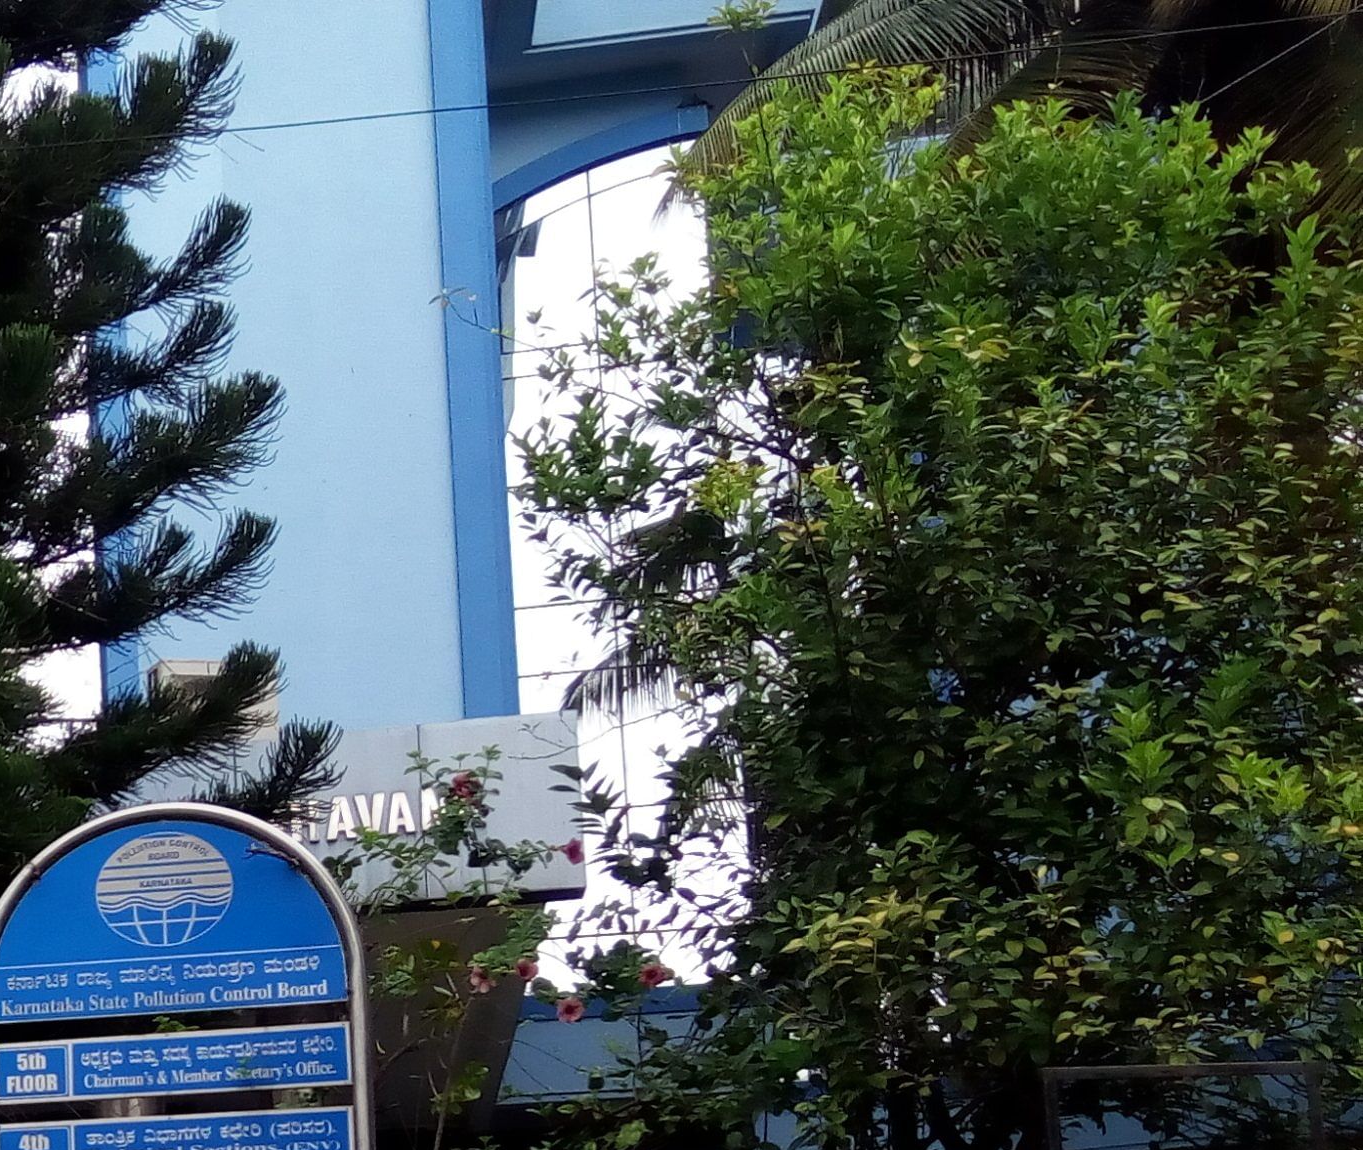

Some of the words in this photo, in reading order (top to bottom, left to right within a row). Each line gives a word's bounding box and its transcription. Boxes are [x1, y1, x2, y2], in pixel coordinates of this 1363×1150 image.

[139, 878, 193, 888] KARNATAKA
[6, 974, 68, 991] ಕರ್ನಾಟಕ
[75, 971, 113, 990] ರಾಜ್ಯ
[119, 964, 175, 986] ಮಾಲಿನ್ಯ
[183, 960, 256, 983] ನಿಯಂತ್ರಣ
[263, 954, 321, 974] ಮಂಡಳಿ
[1, 997, 84, 1017] Karnataka
[89, 994, 129, 1011] State
[133, 988, 205, 1008] Pollution
[209, 983, 273, 1003] Control
[277, 979, 328, 998] Board
[16, 1052, 47, 1072] 5th
[6, 1073, 59, 1094] FLOOR
[84, 1070, 154, 1089] Chairman's
[156, 1070, 168, 1085] &
[171, 1068, 223, 1084] Member
[86, 1129, 136, 1147] ತಾಂತ್ರಿಕ
